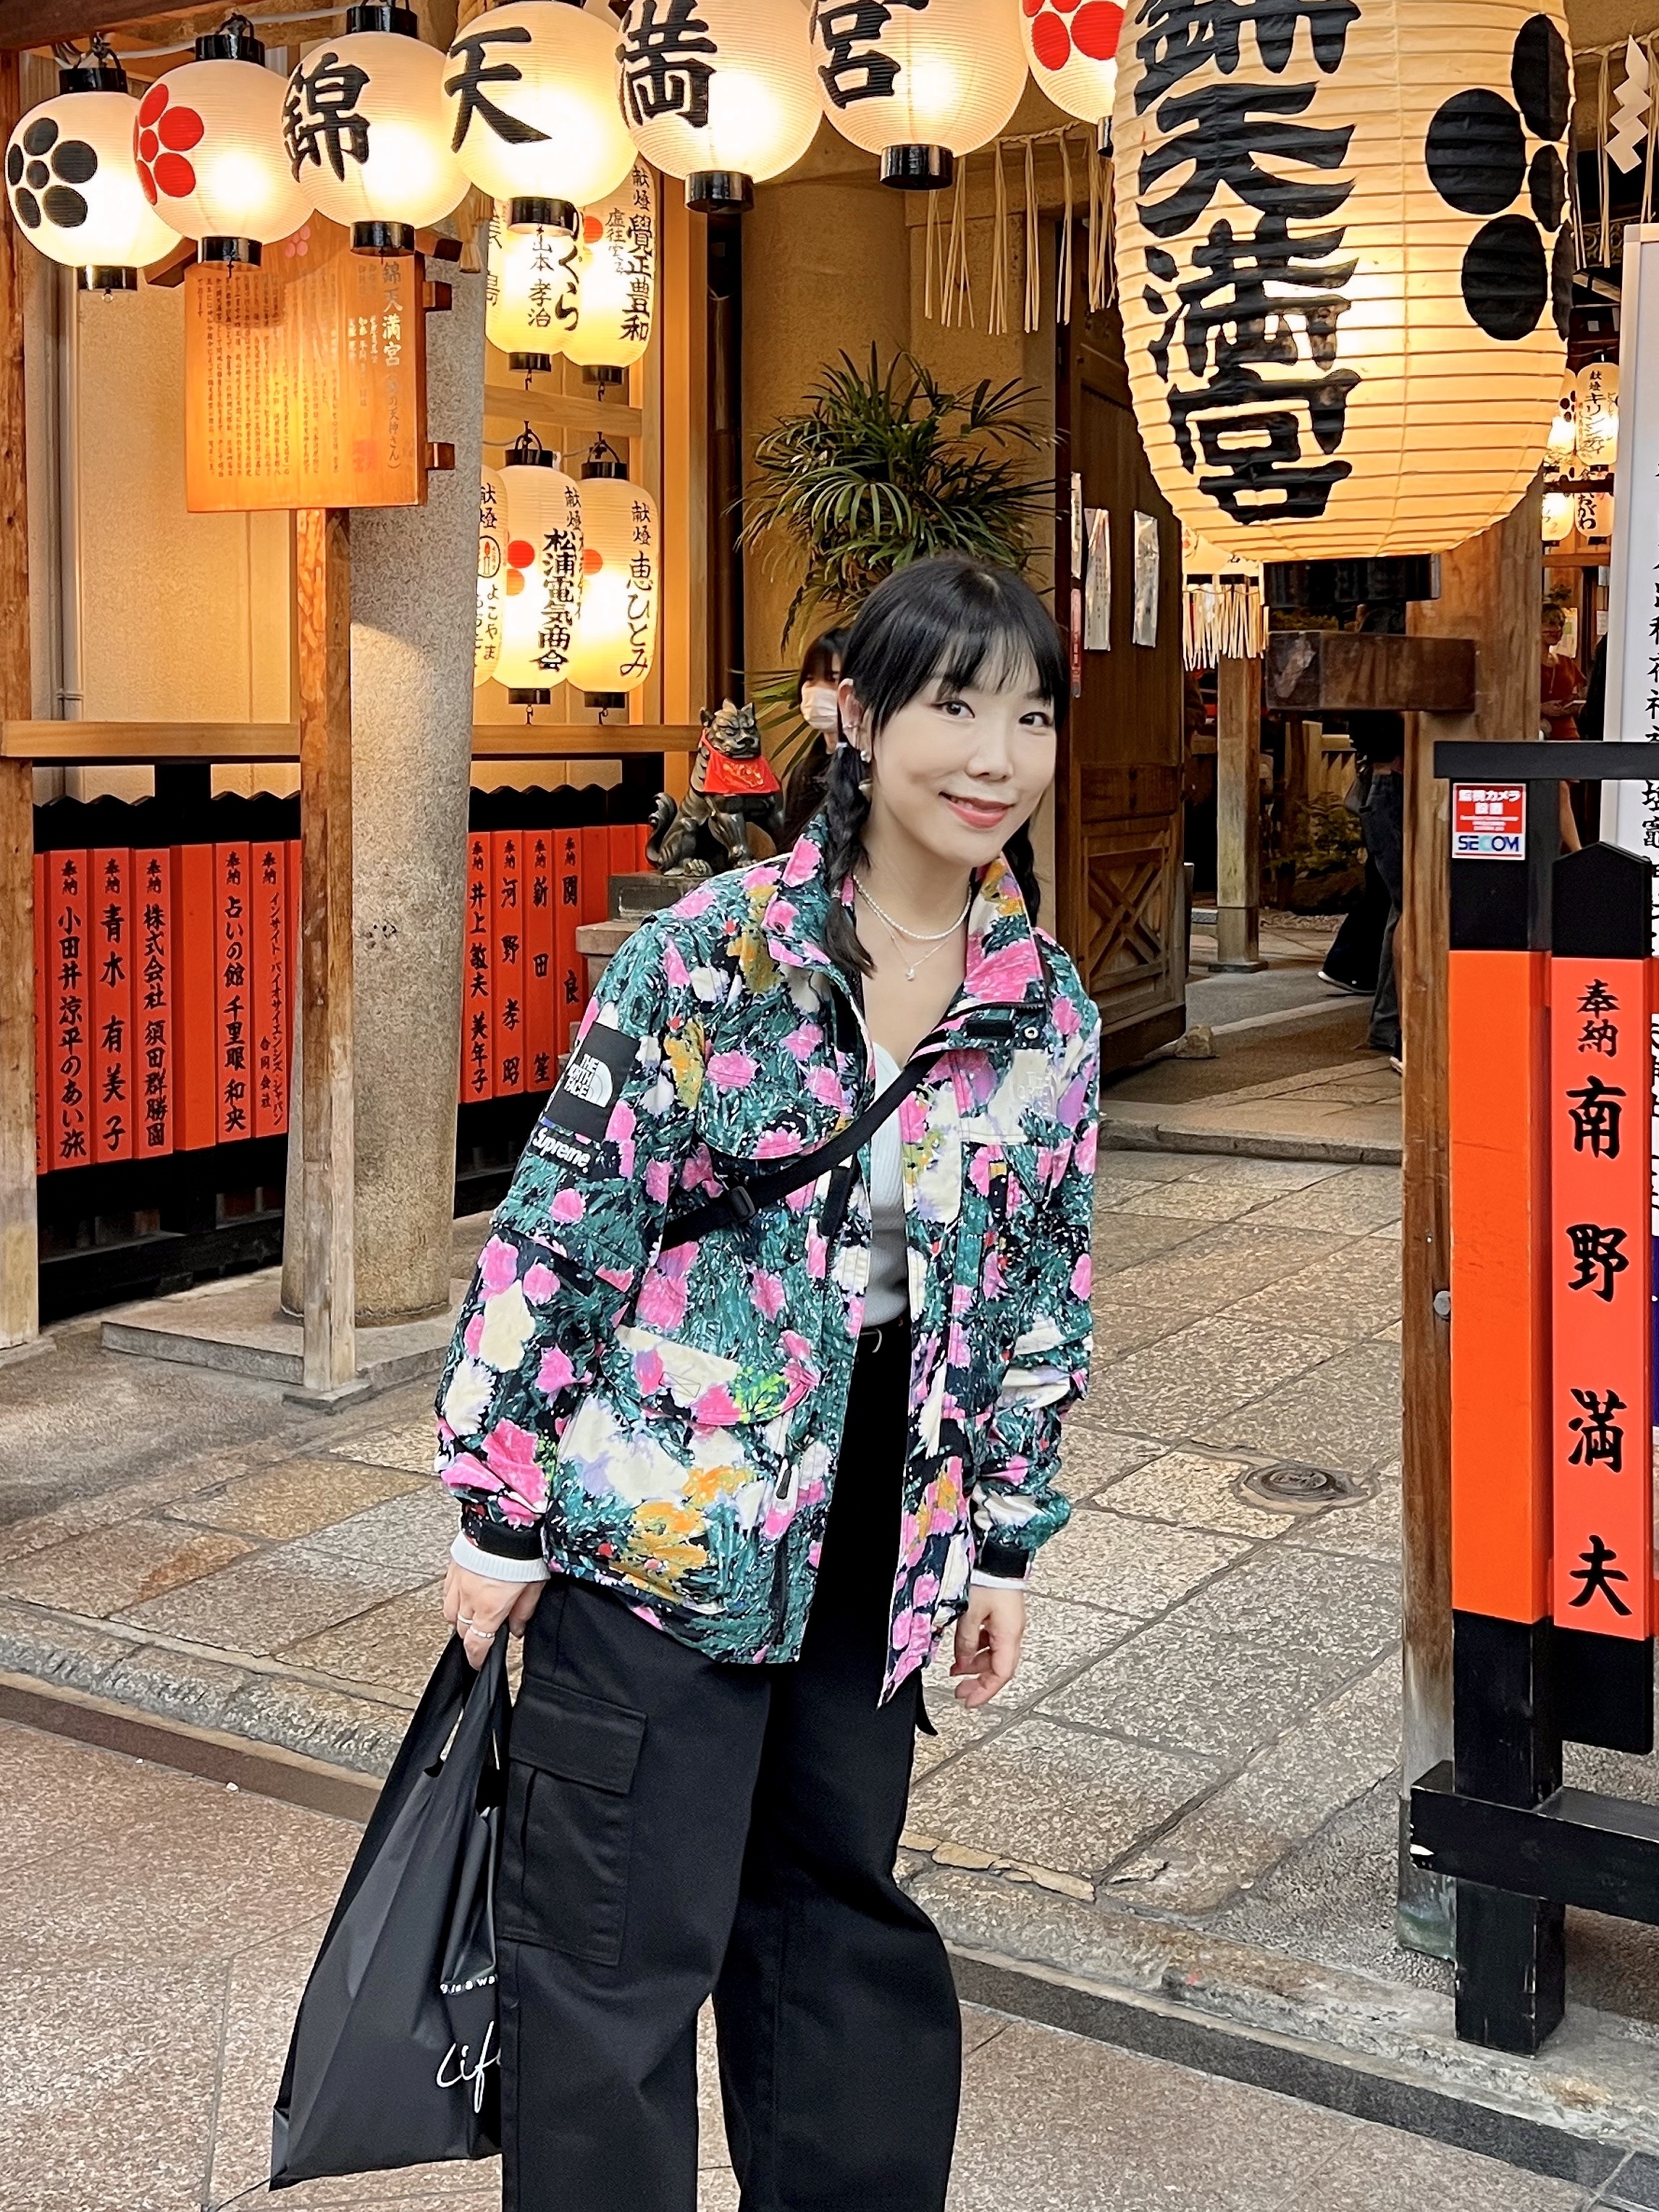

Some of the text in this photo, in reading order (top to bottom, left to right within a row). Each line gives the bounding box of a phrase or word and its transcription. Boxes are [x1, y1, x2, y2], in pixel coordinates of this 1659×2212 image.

[282, 52, 370, 183] 錦
[445, 27, 553, 154] 天
[382, 262, 403, 366] 錦天満宮
[483, 584, 500, 660] よこやま
[530, 528, 579, 672] 松浦電気商会
[620, 550, 655, 678] 恵ひとみ
[1458, 835, 1520, 852] SECOM
[143, 903, 167, 1011] 株式会社
[1576, 977, 1621, 1058] 奉納
[563, 1077, 589, 1098] FACE
[579, 1053, 600, 1073] THE
[532, 1127, 591, 1168] Supreme
